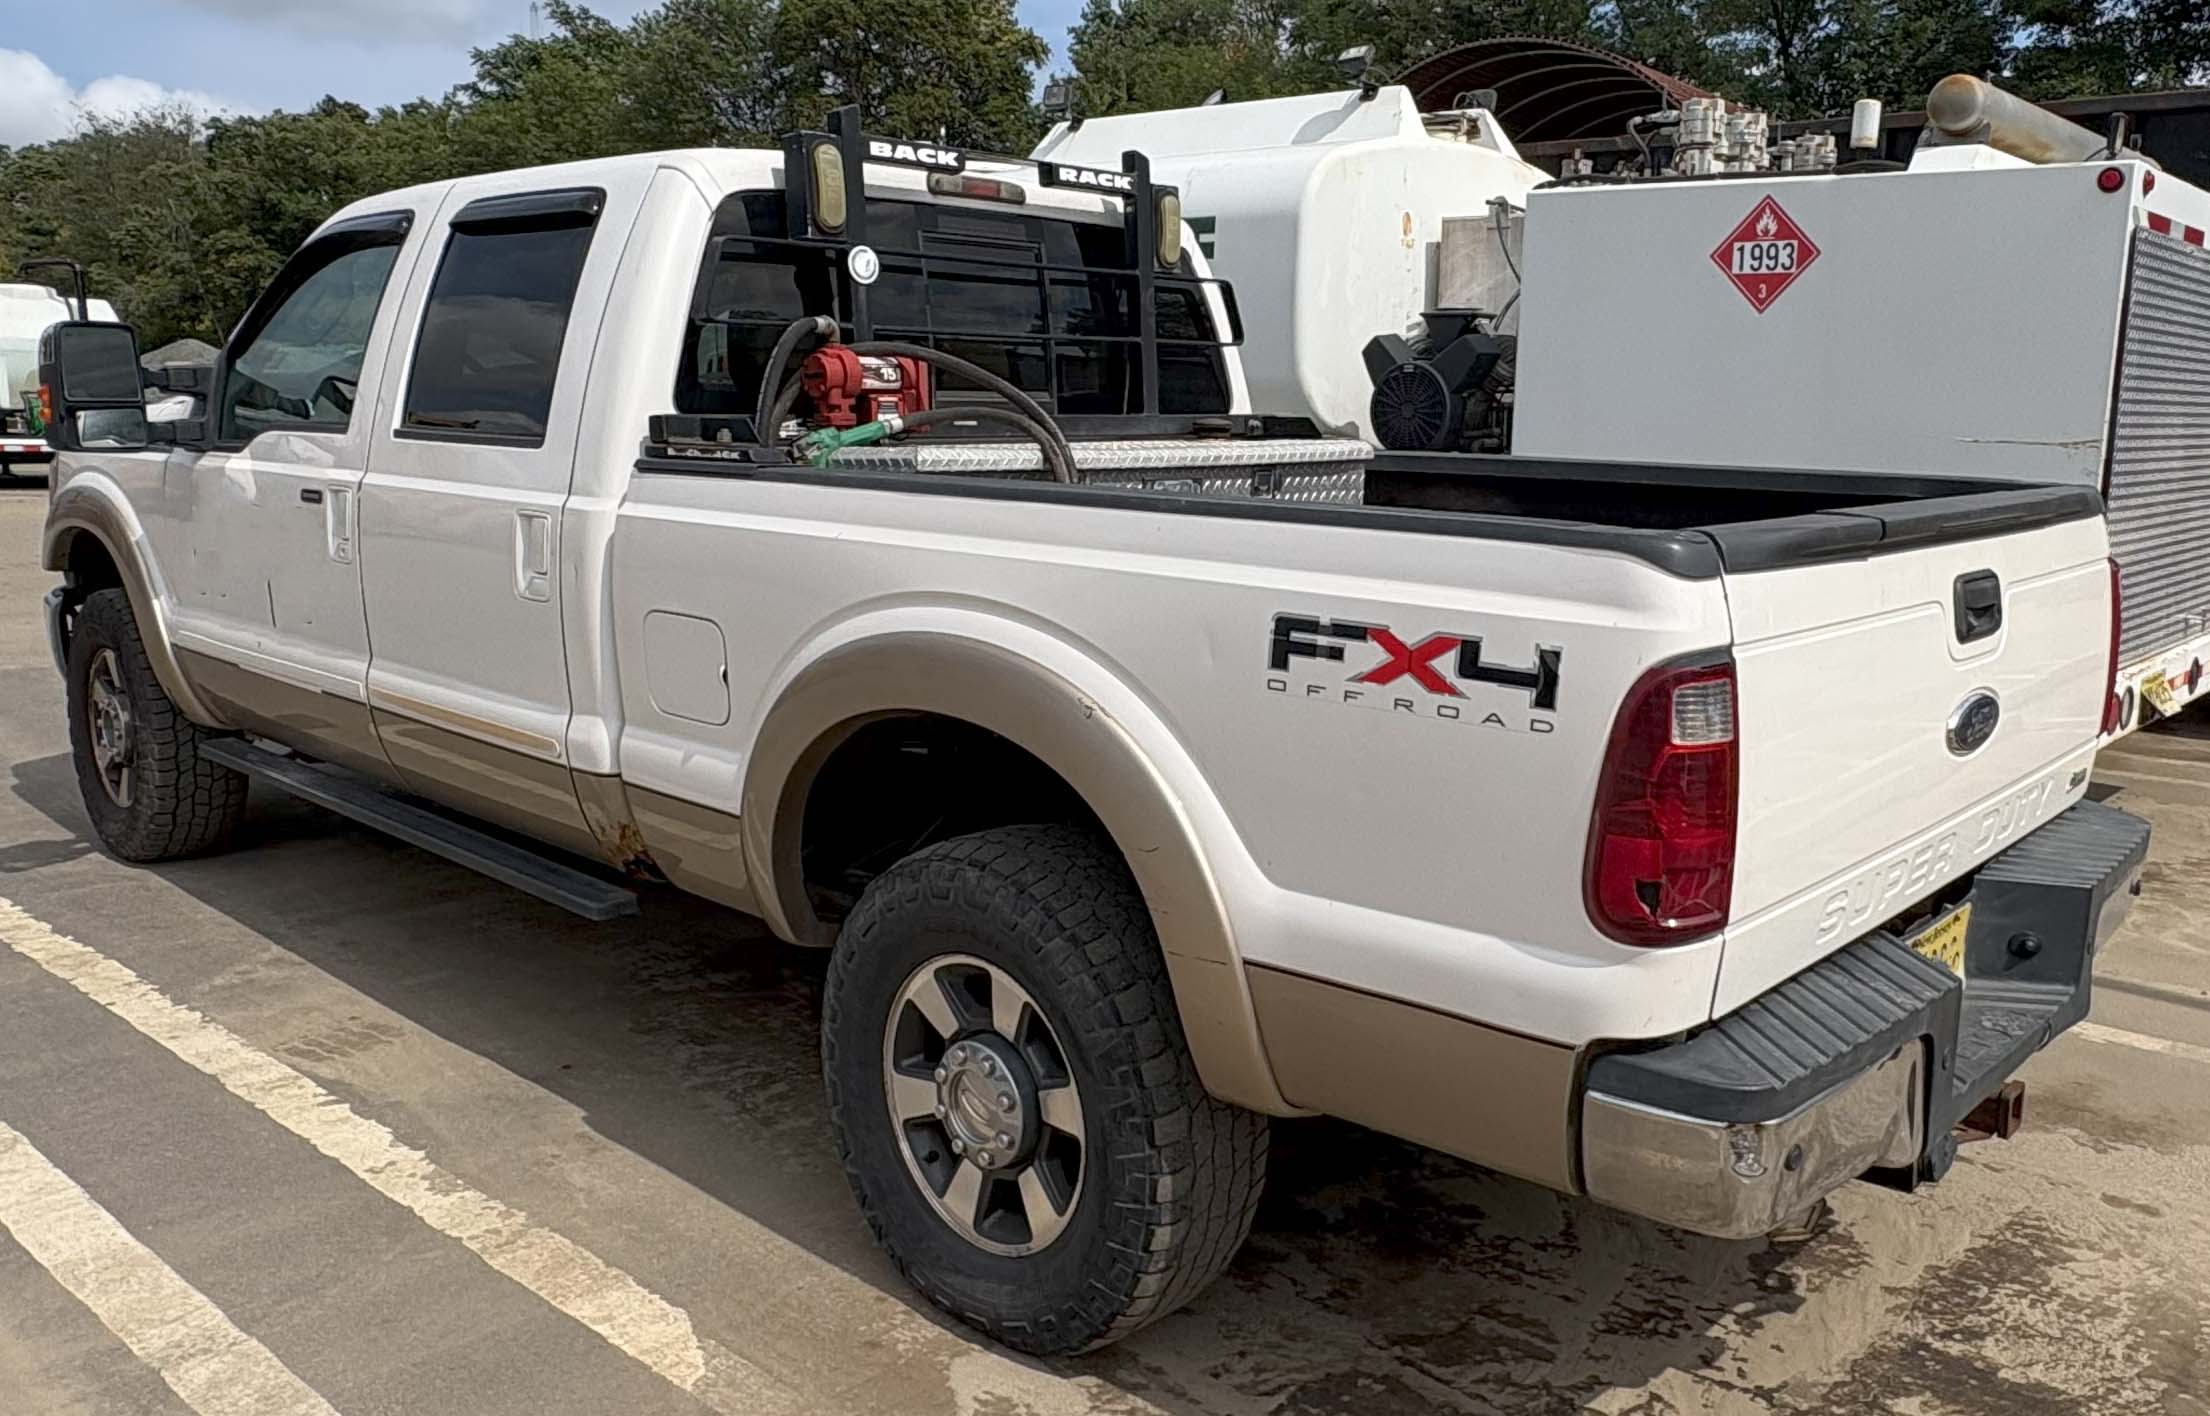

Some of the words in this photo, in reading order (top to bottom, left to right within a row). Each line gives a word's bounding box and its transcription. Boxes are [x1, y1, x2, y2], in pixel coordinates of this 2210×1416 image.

[869, 140, 960, 167] BACK
[1058, 166, 1133, 190] RACK
[1736, 242, 1795, 272] 1993
[1758, 284, 1767, 298] 3
[880, 367, 897, 380] 15
[1267, 611, 1564, 712] FX4
[1267, 678, 1364, 703] OFF
[1394, 698, 1555, 734] ROAD
[1815, 831, 1957, 946] SUPER
[1973, 778, 2055, 854] DUTY
